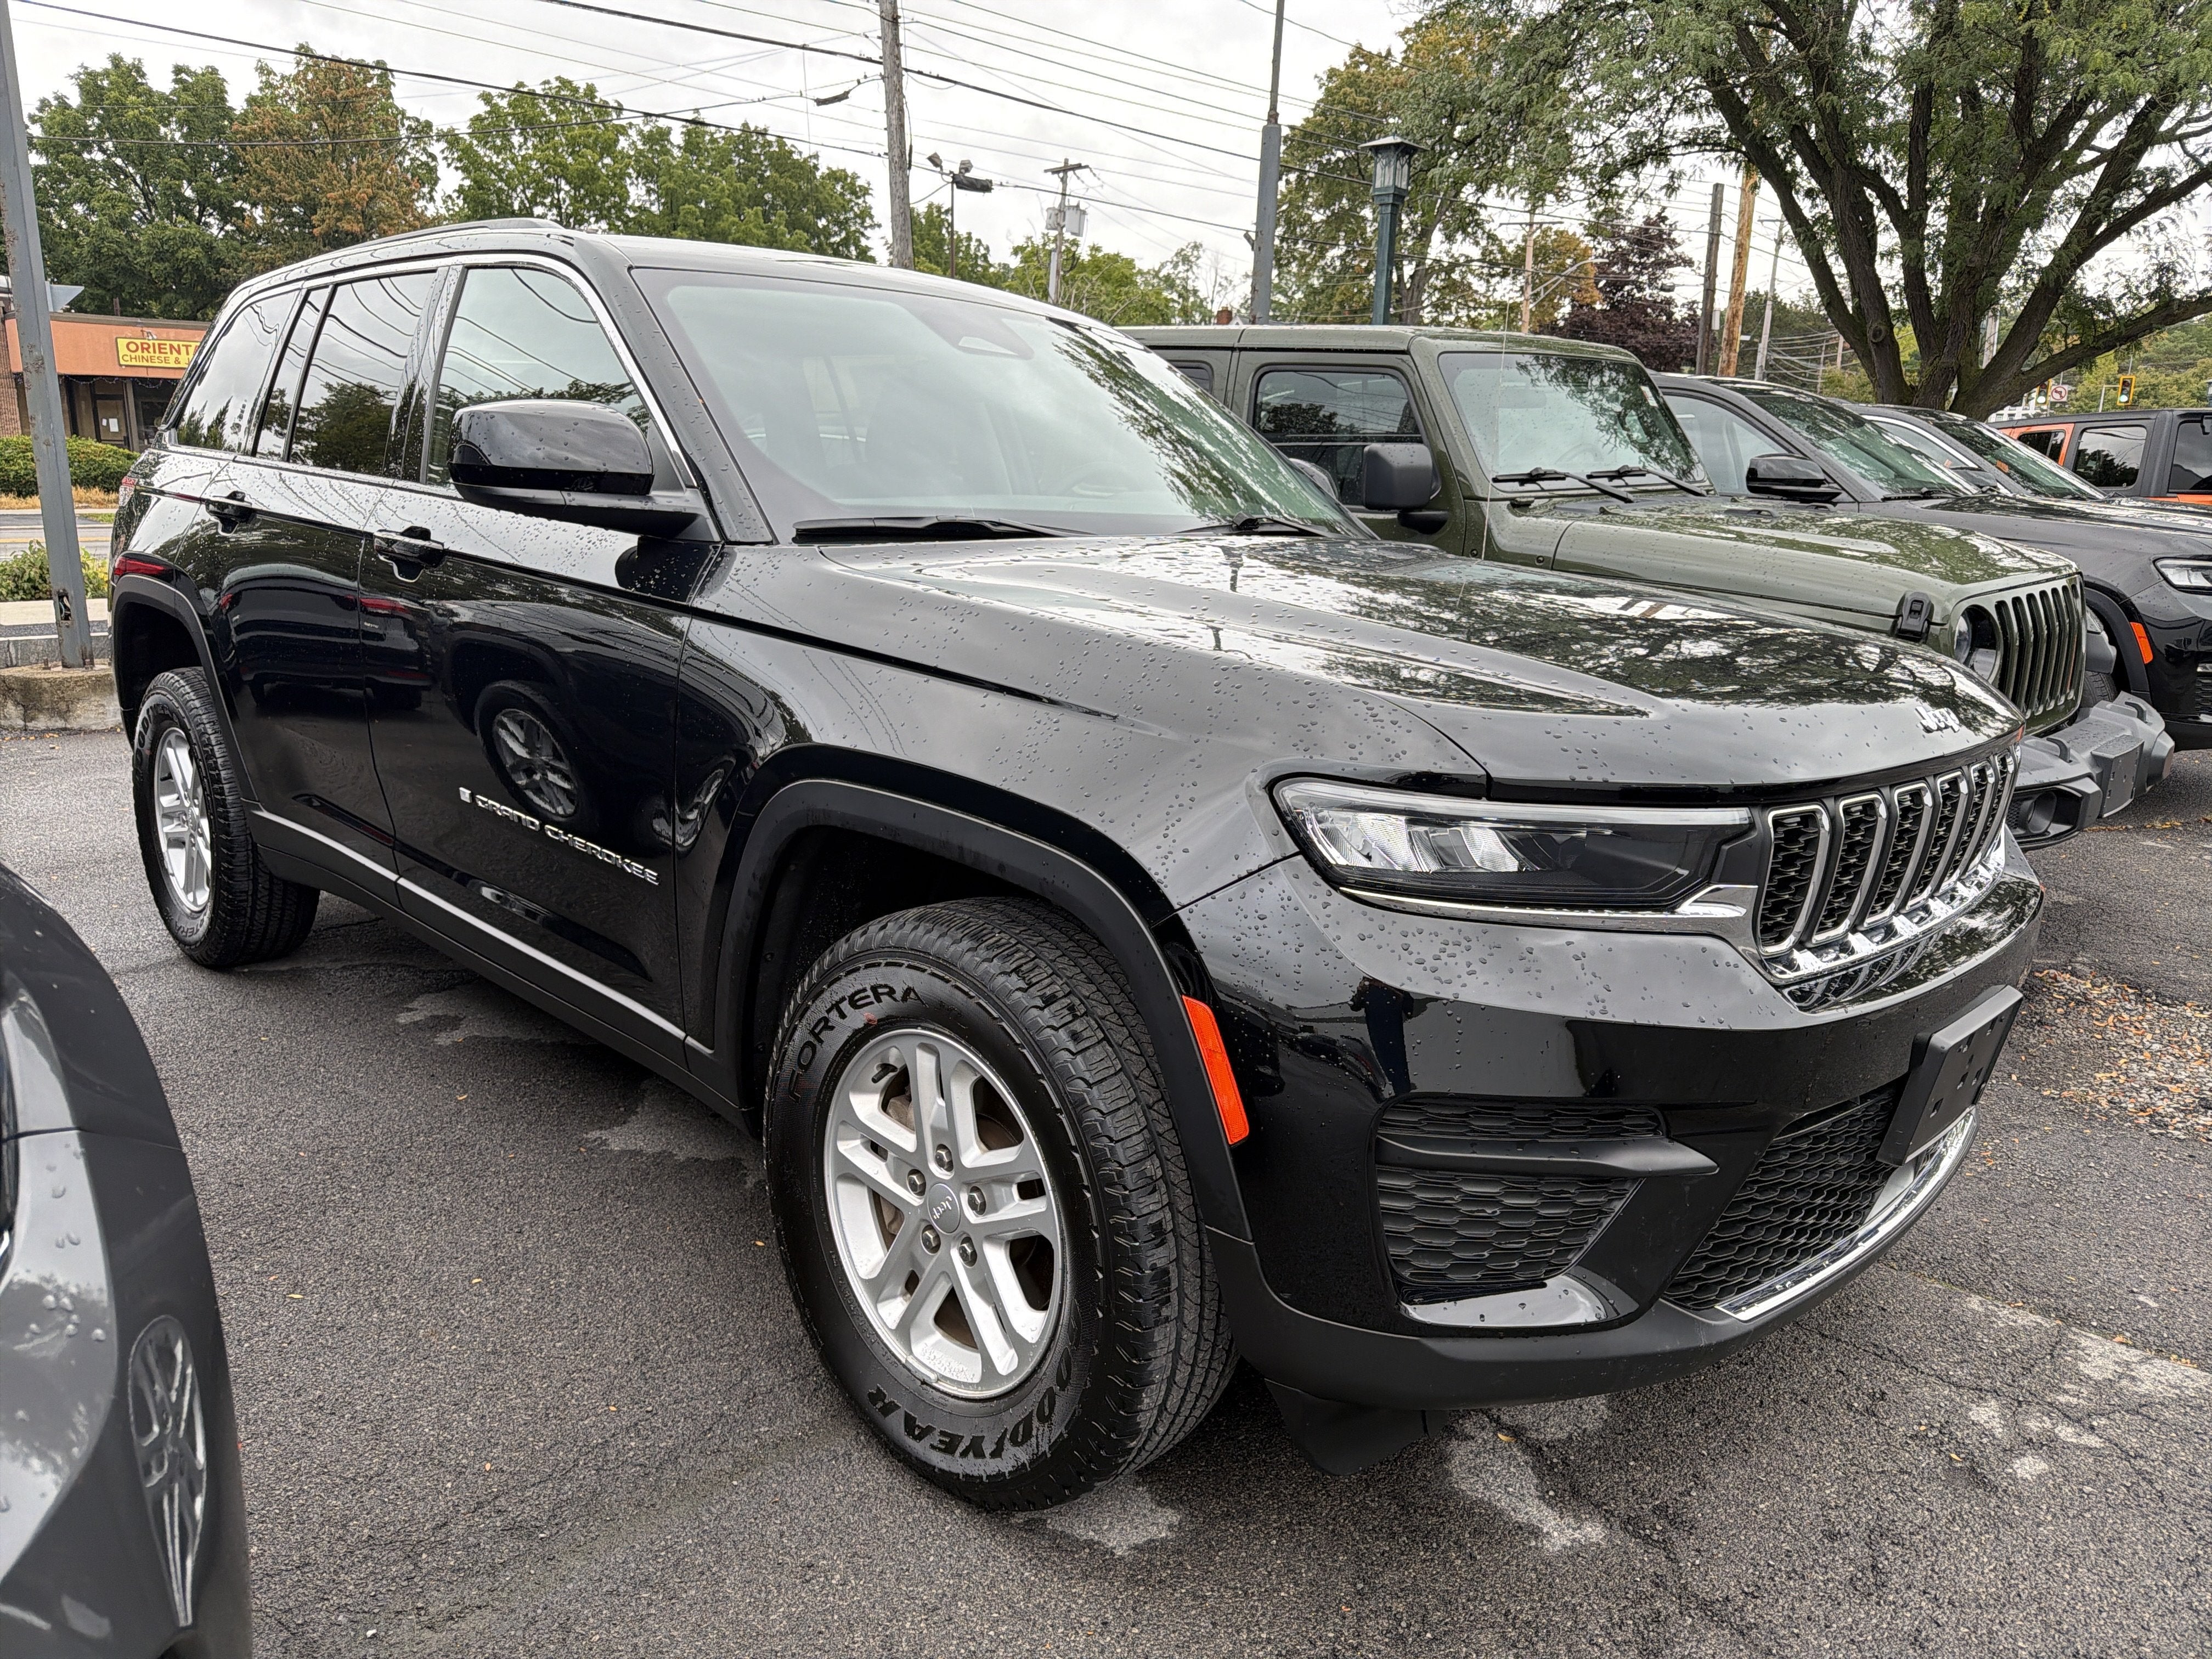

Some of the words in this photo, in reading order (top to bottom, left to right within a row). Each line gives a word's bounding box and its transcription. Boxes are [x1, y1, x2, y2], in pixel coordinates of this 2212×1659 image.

[122, 354, 171, 364] CHINESE
[1915, 706, 1960, 733] Jeep
[475, 794, 540, 832] GRAND
[544, 824, 659, 885] CHEROKEE
[788, 984, 929, 1104] FORTERA
[933, 1195, 952, 1220] Jeep
